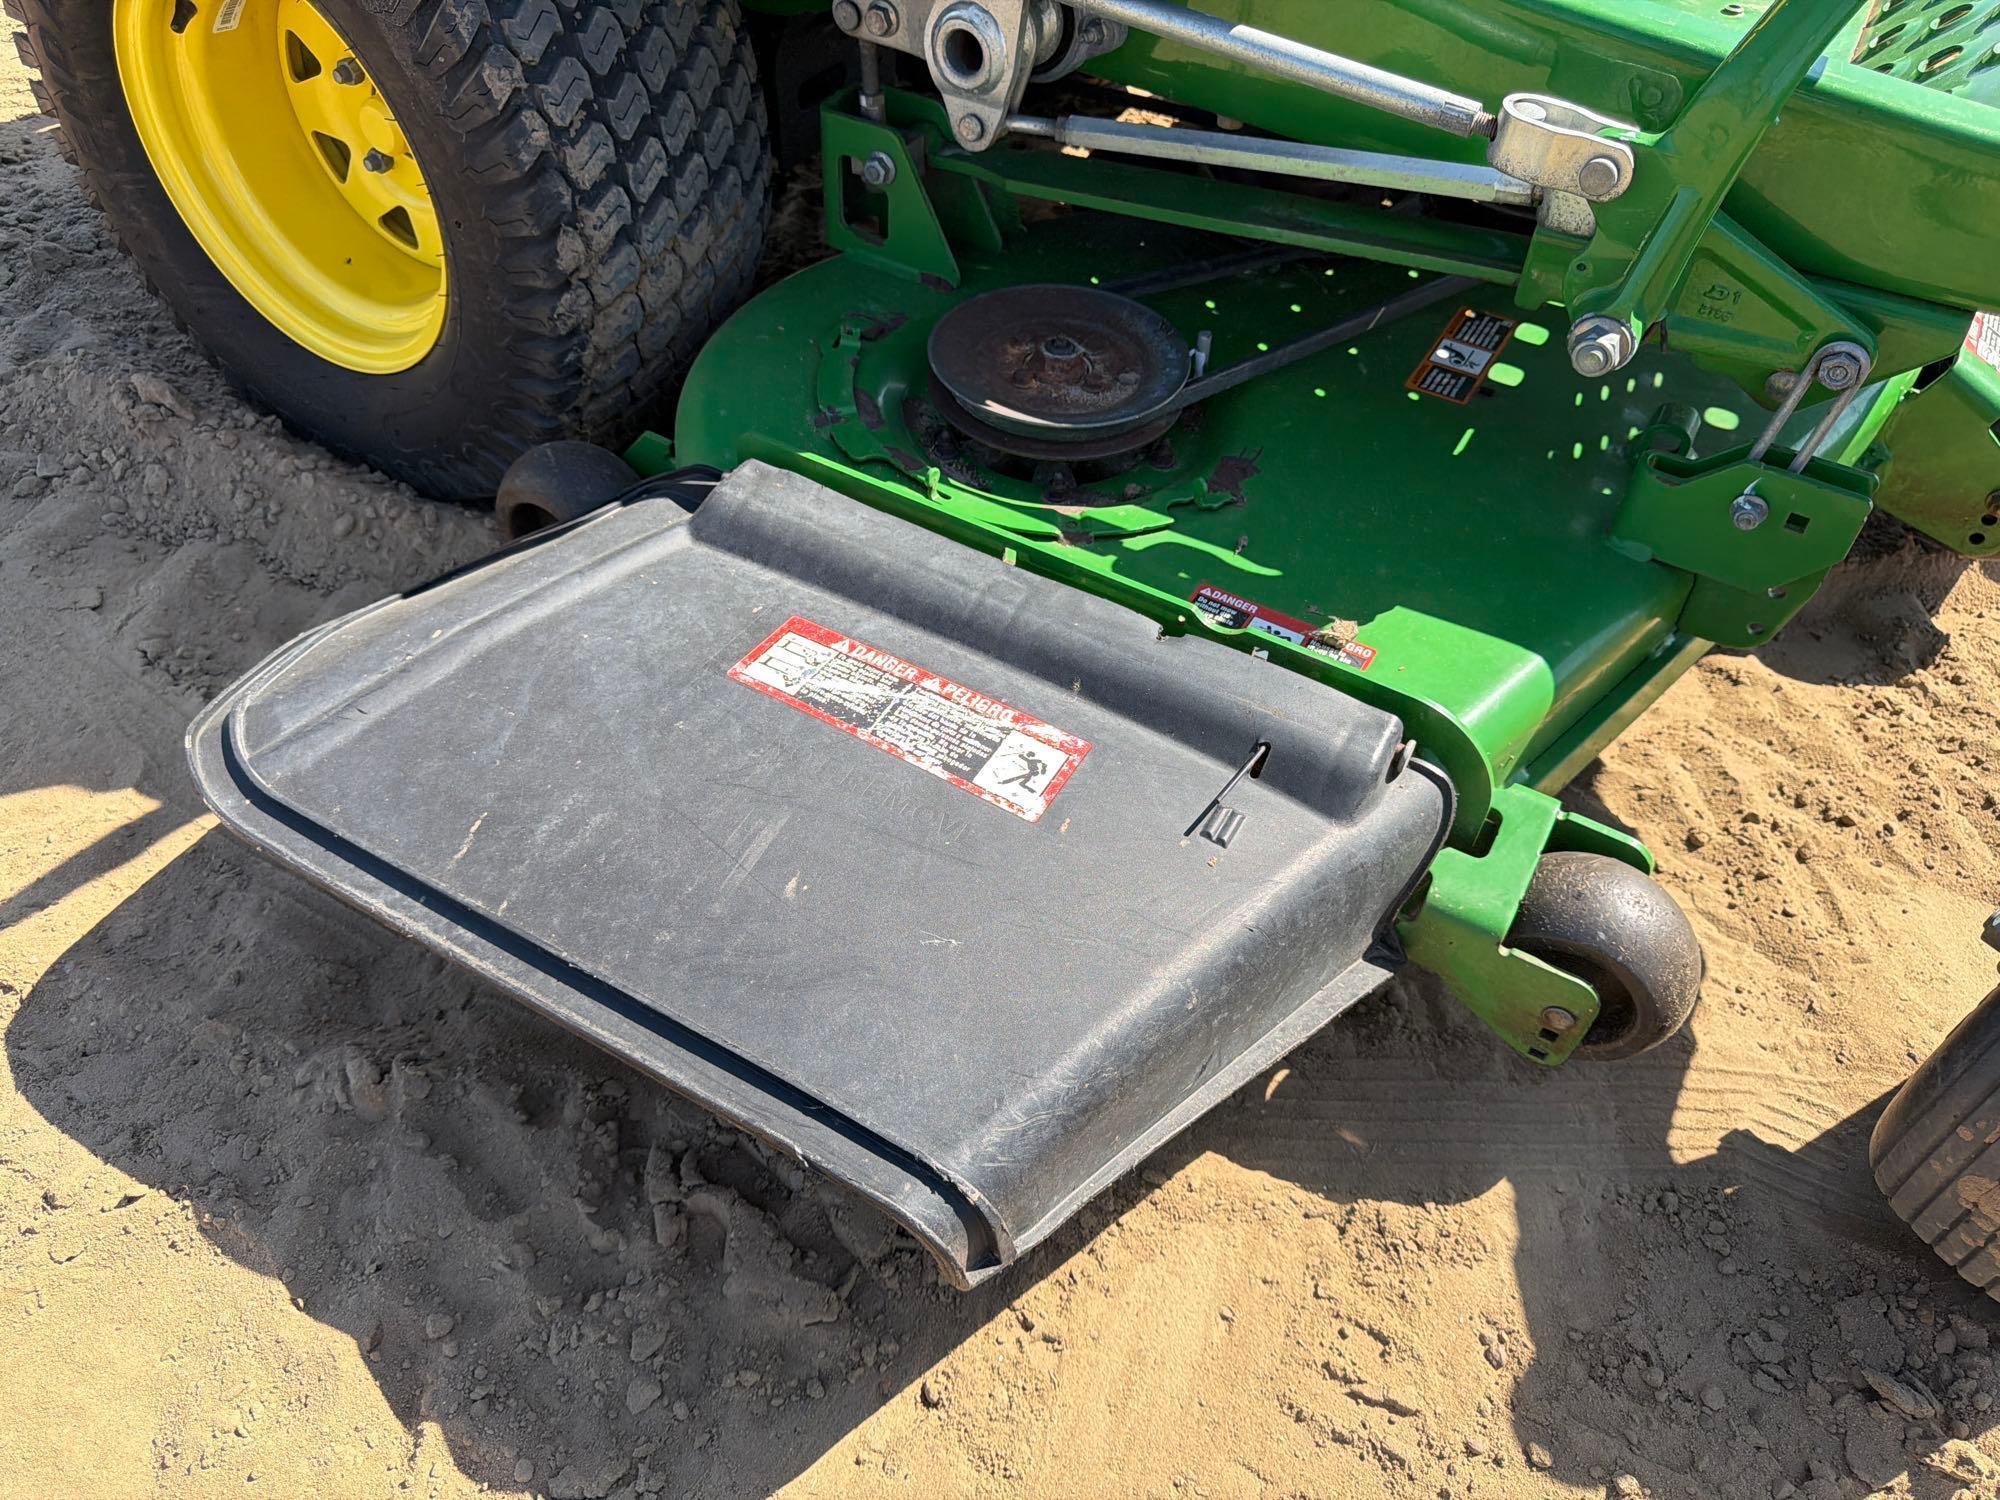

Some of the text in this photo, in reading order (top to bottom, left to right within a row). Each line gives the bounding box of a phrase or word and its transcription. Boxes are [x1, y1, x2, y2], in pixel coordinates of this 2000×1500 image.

[1208, 600, 1221, 609] not
[1221, 605, 1237, 615] mow
[1212, 591, 1258, 613] DANGER
[849, 643, 919, 680] DANGER
[941, 683, 1014, 722] PELIGRO
